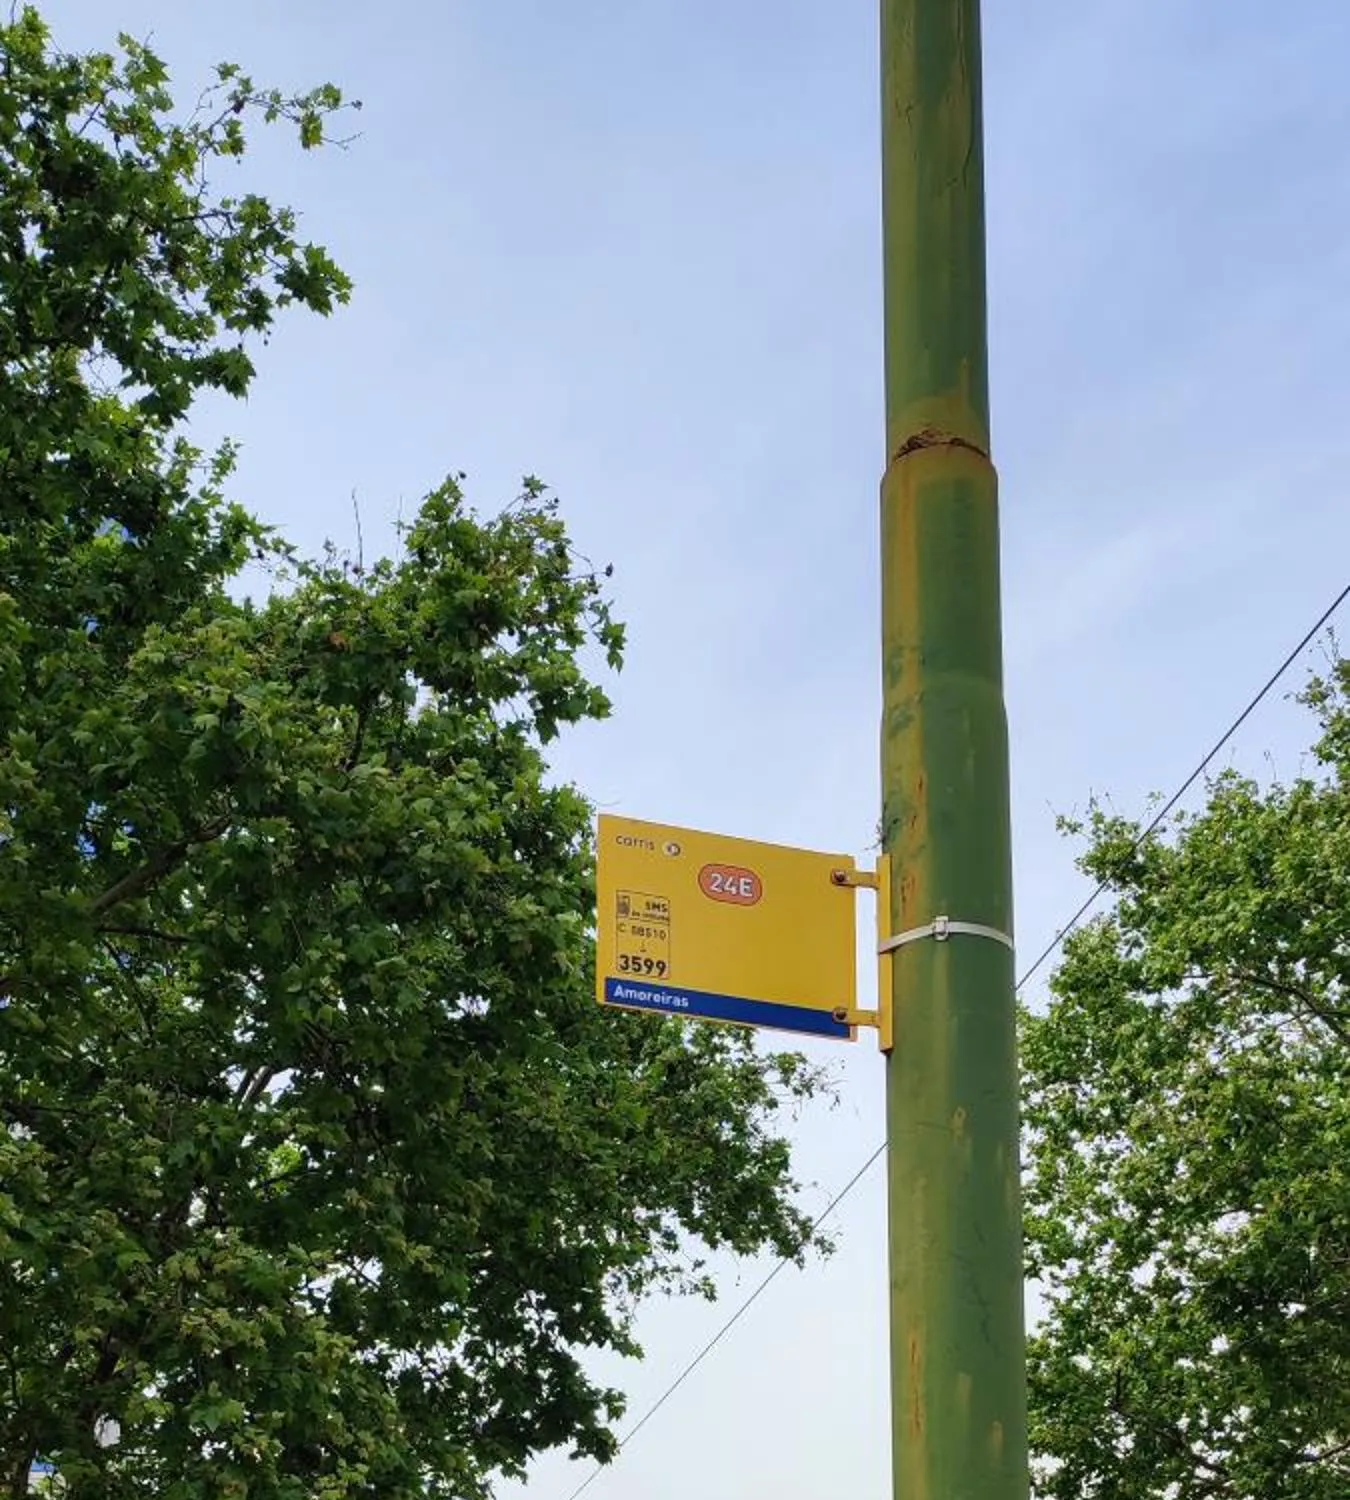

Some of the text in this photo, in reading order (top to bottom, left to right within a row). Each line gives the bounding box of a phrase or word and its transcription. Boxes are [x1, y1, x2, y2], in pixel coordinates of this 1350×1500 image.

[709, 873, 753, 897] 24E
[619, 954, 667, 977] 3599
[613, 984, 689, 1007] Amoreiras
